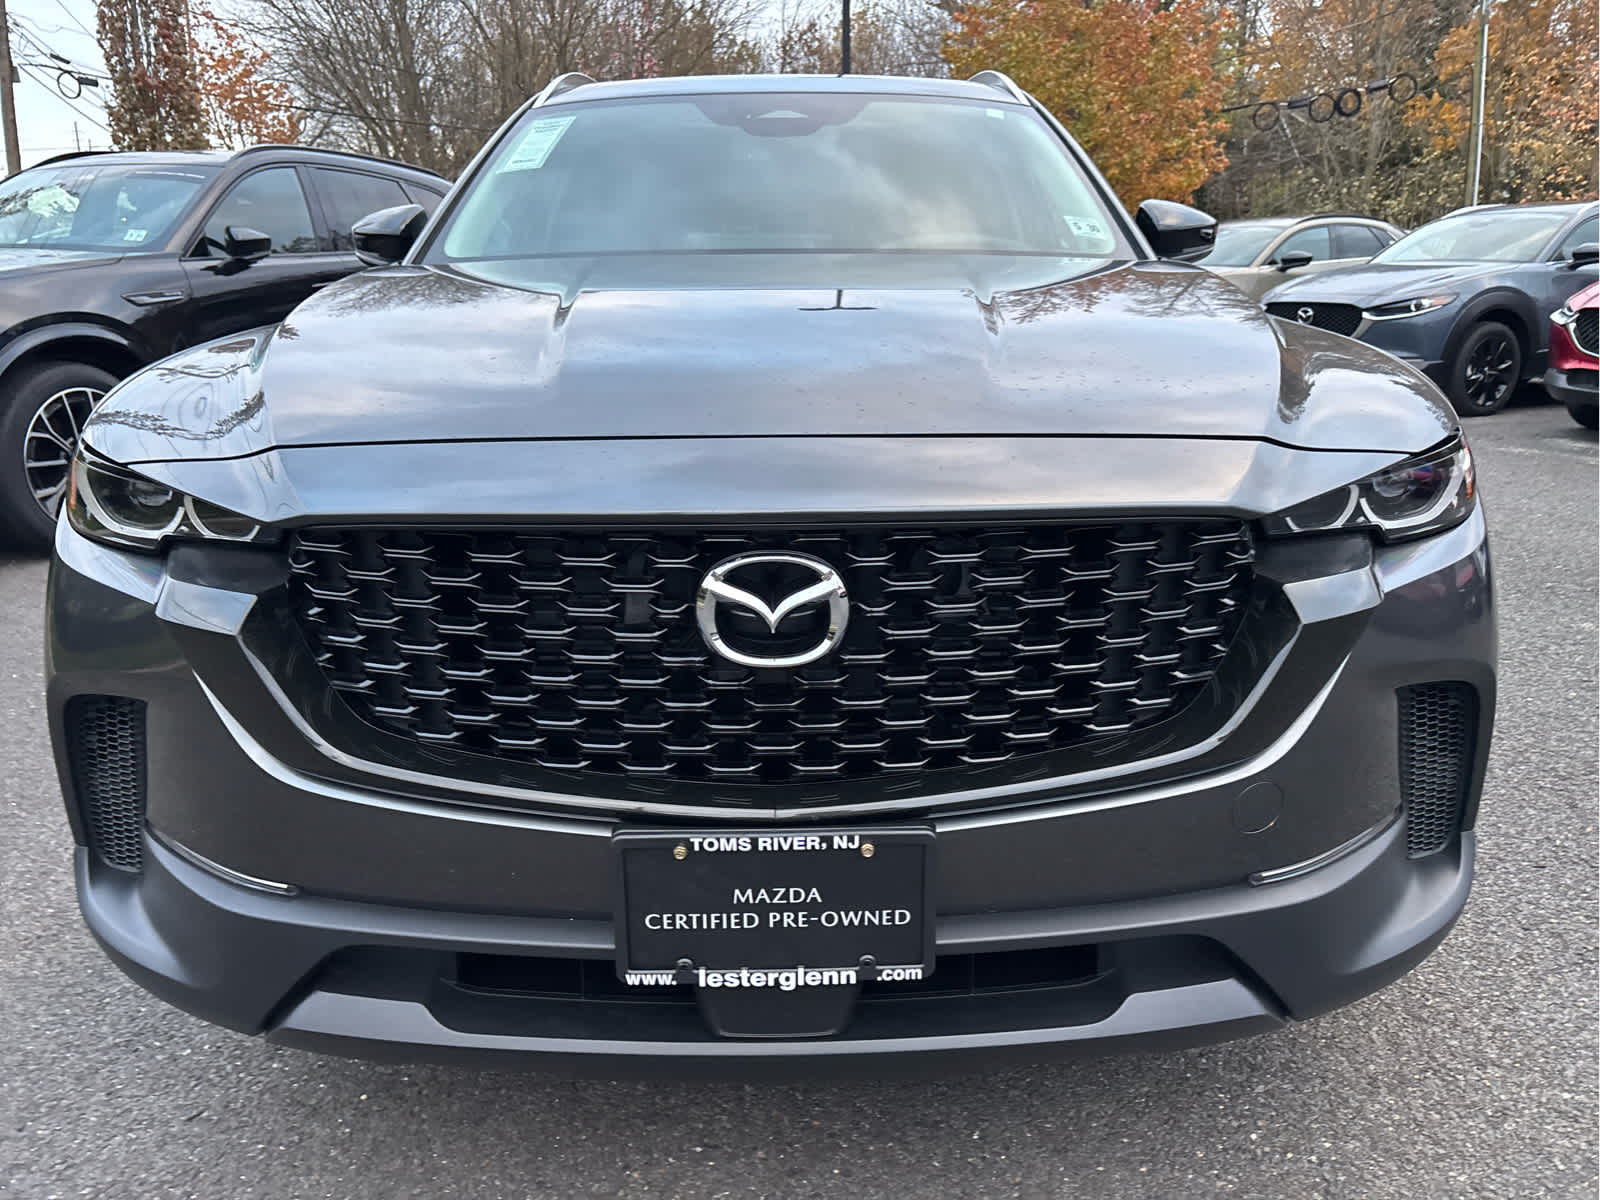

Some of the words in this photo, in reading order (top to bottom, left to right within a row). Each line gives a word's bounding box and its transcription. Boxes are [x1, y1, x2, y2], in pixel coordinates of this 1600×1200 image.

[690, 836, 751, 852] TOMS
[758, 836, 827, 851] RIVER,
[833, 835, 860, 850] NJ
[733, 887, 822, 904] MAZDA
[645, 913, 759, 930] CERTIFIED
[768, 909, 911, 928] PRE-OWNED
[625, 972, 677, 986] www.
[698, 966, 857, 991] lesterglenn
[876, 967, 923, 982] .com
